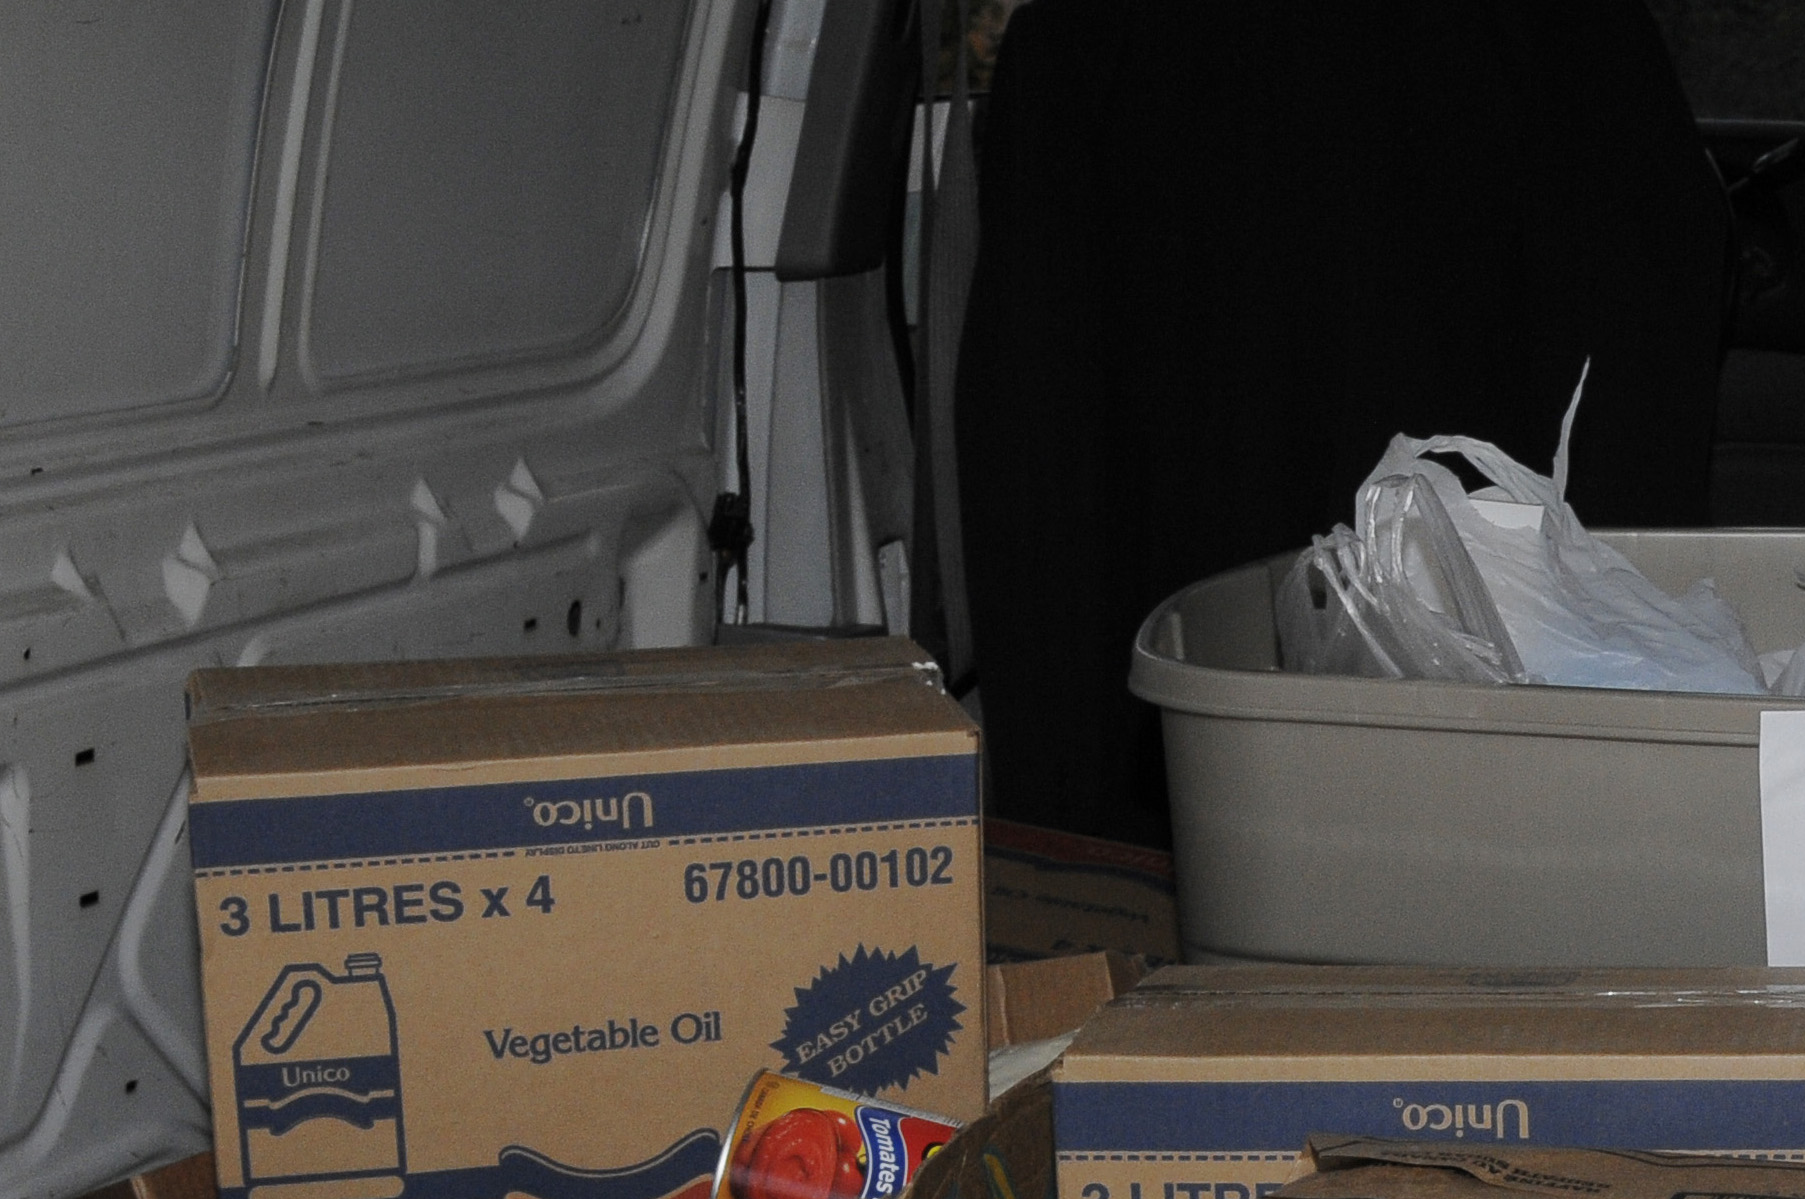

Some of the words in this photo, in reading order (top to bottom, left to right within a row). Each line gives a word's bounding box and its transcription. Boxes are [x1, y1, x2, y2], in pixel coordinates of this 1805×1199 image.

[532, 792, 653, 830] Unico
[684, 846, 953, 903] 67800-00102
[219, 895, 250, 937] 3
[269, 880, 465, 934] LITRES
[480, 887, 511, 918] x
[526, 875, 555, 915] 4
[483, 1018, 660, 1064] Vegetable
[670, 1011, 722, 1044] Oil
[795, 1008, 862, 1064] EASY
[868, 969, 929, 1017] GRIP
[825, 1003, 929, 1077] BOTTLE
[282, 1066, 350, 1087] Unico
[1403, 1099, 1530, 1138] Unico
[868, 1116, 900, 1194] Tomates
